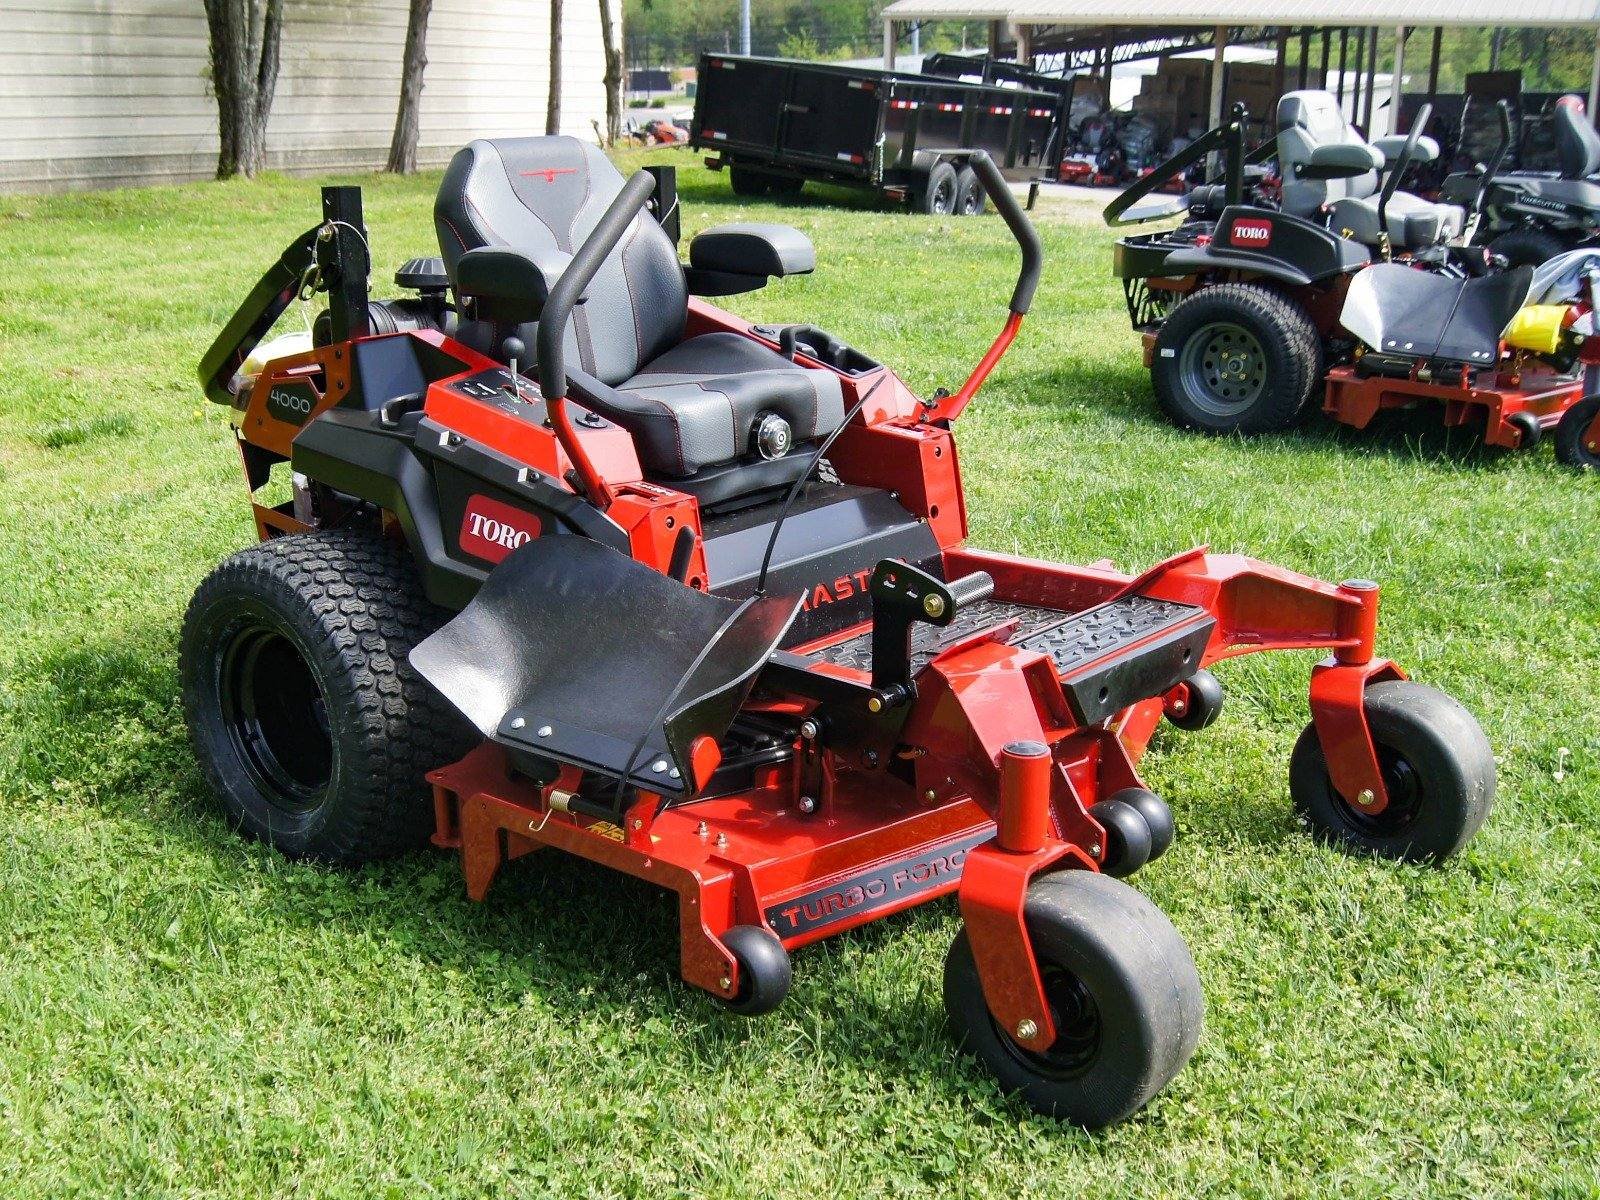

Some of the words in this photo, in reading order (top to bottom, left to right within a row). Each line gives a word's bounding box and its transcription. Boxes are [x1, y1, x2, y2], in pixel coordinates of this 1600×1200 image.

[1234, 226, 1269, 239] TORO
[271, 390, 310, 412] 4000
[470, 512, 531, 549] TORO
[781, 878, 887, 928] TURBO
[892, 849, 965, 891] FORC
